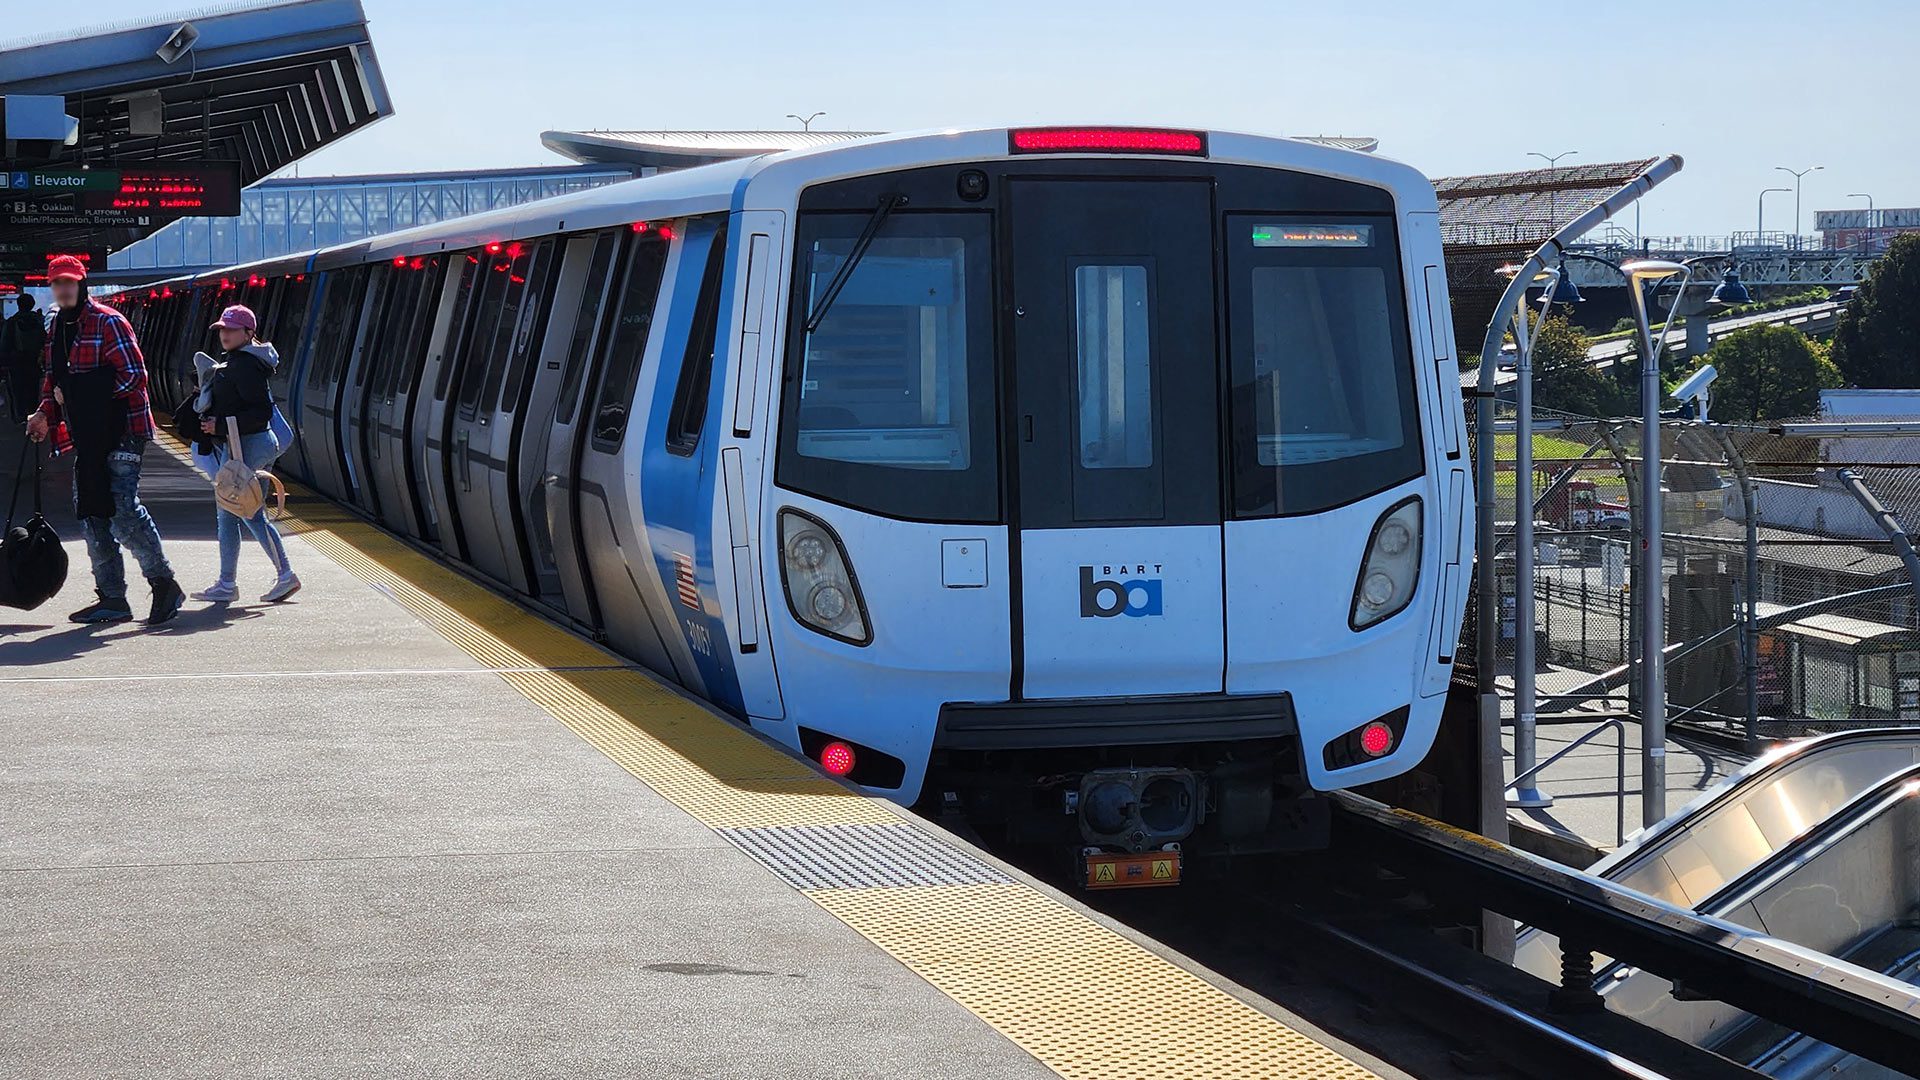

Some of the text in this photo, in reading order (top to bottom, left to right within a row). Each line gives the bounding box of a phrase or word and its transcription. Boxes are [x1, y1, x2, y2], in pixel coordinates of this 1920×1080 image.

[34, 175, 86, 187] Elevator
[10, 216, 92, 225] Dublin/Pleasanton,
[94, 216, 135, 226] Berryessa
[1103, 564, 1162, 575] BART
